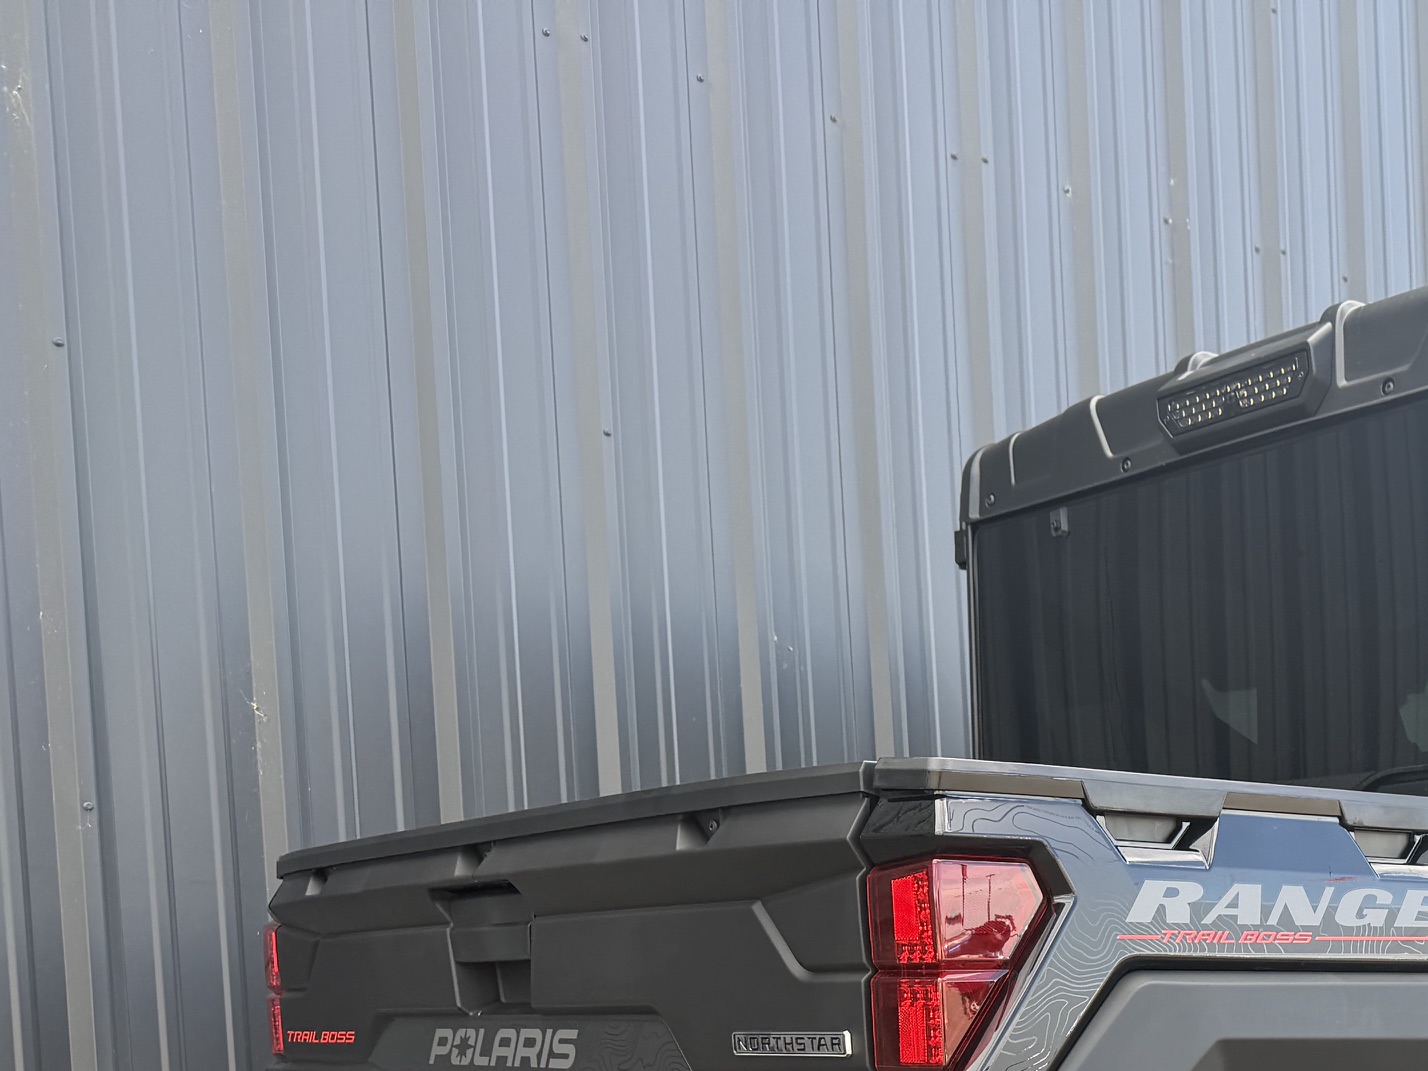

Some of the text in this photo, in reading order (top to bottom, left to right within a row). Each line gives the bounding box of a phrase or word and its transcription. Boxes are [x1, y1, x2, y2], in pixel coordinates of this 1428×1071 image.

[1161, 930, 1313, 945] TRAIL BOSS
[287, 1030, 356, 1044] TRAIL BOSS
[737, 1036, 842, 1052] NORTHSTAR
[428, 1028, 579, 1070] POLARIS
